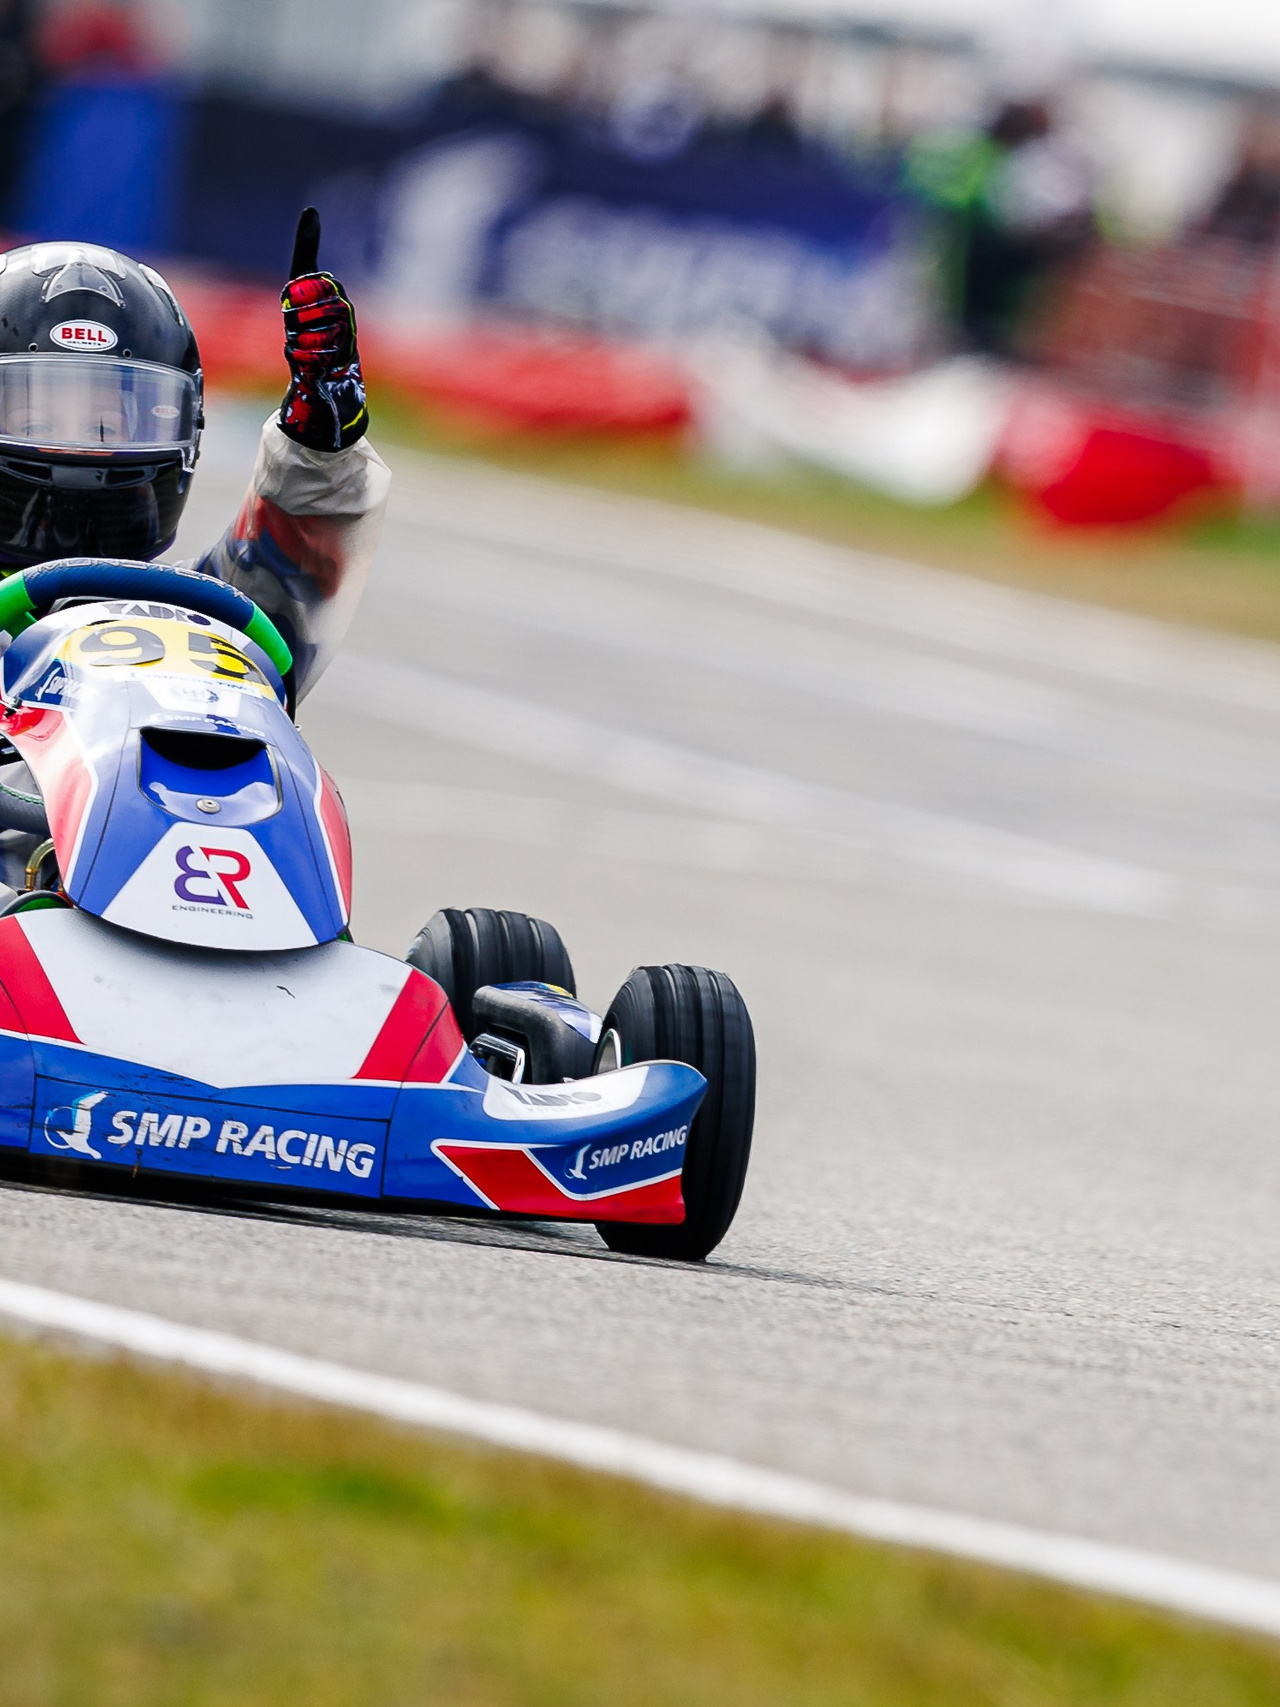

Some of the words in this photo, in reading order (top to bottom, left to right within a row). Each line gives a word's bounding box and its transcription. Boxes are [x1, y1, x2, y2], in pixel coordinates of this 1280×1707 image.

[61, 327, 108, 343] BELL
[80, 625, 268, 685] 95
[204, 717, 266, 738] RACING
[172, 904, 254, 920] ENGINEERING
[107, 1110, 211, 1149] SMP
[216, 1119, 377, 1179] RACING
[589, 1143, 630, 1170] SMP
[630, 1124, 688, 1160] RACING
